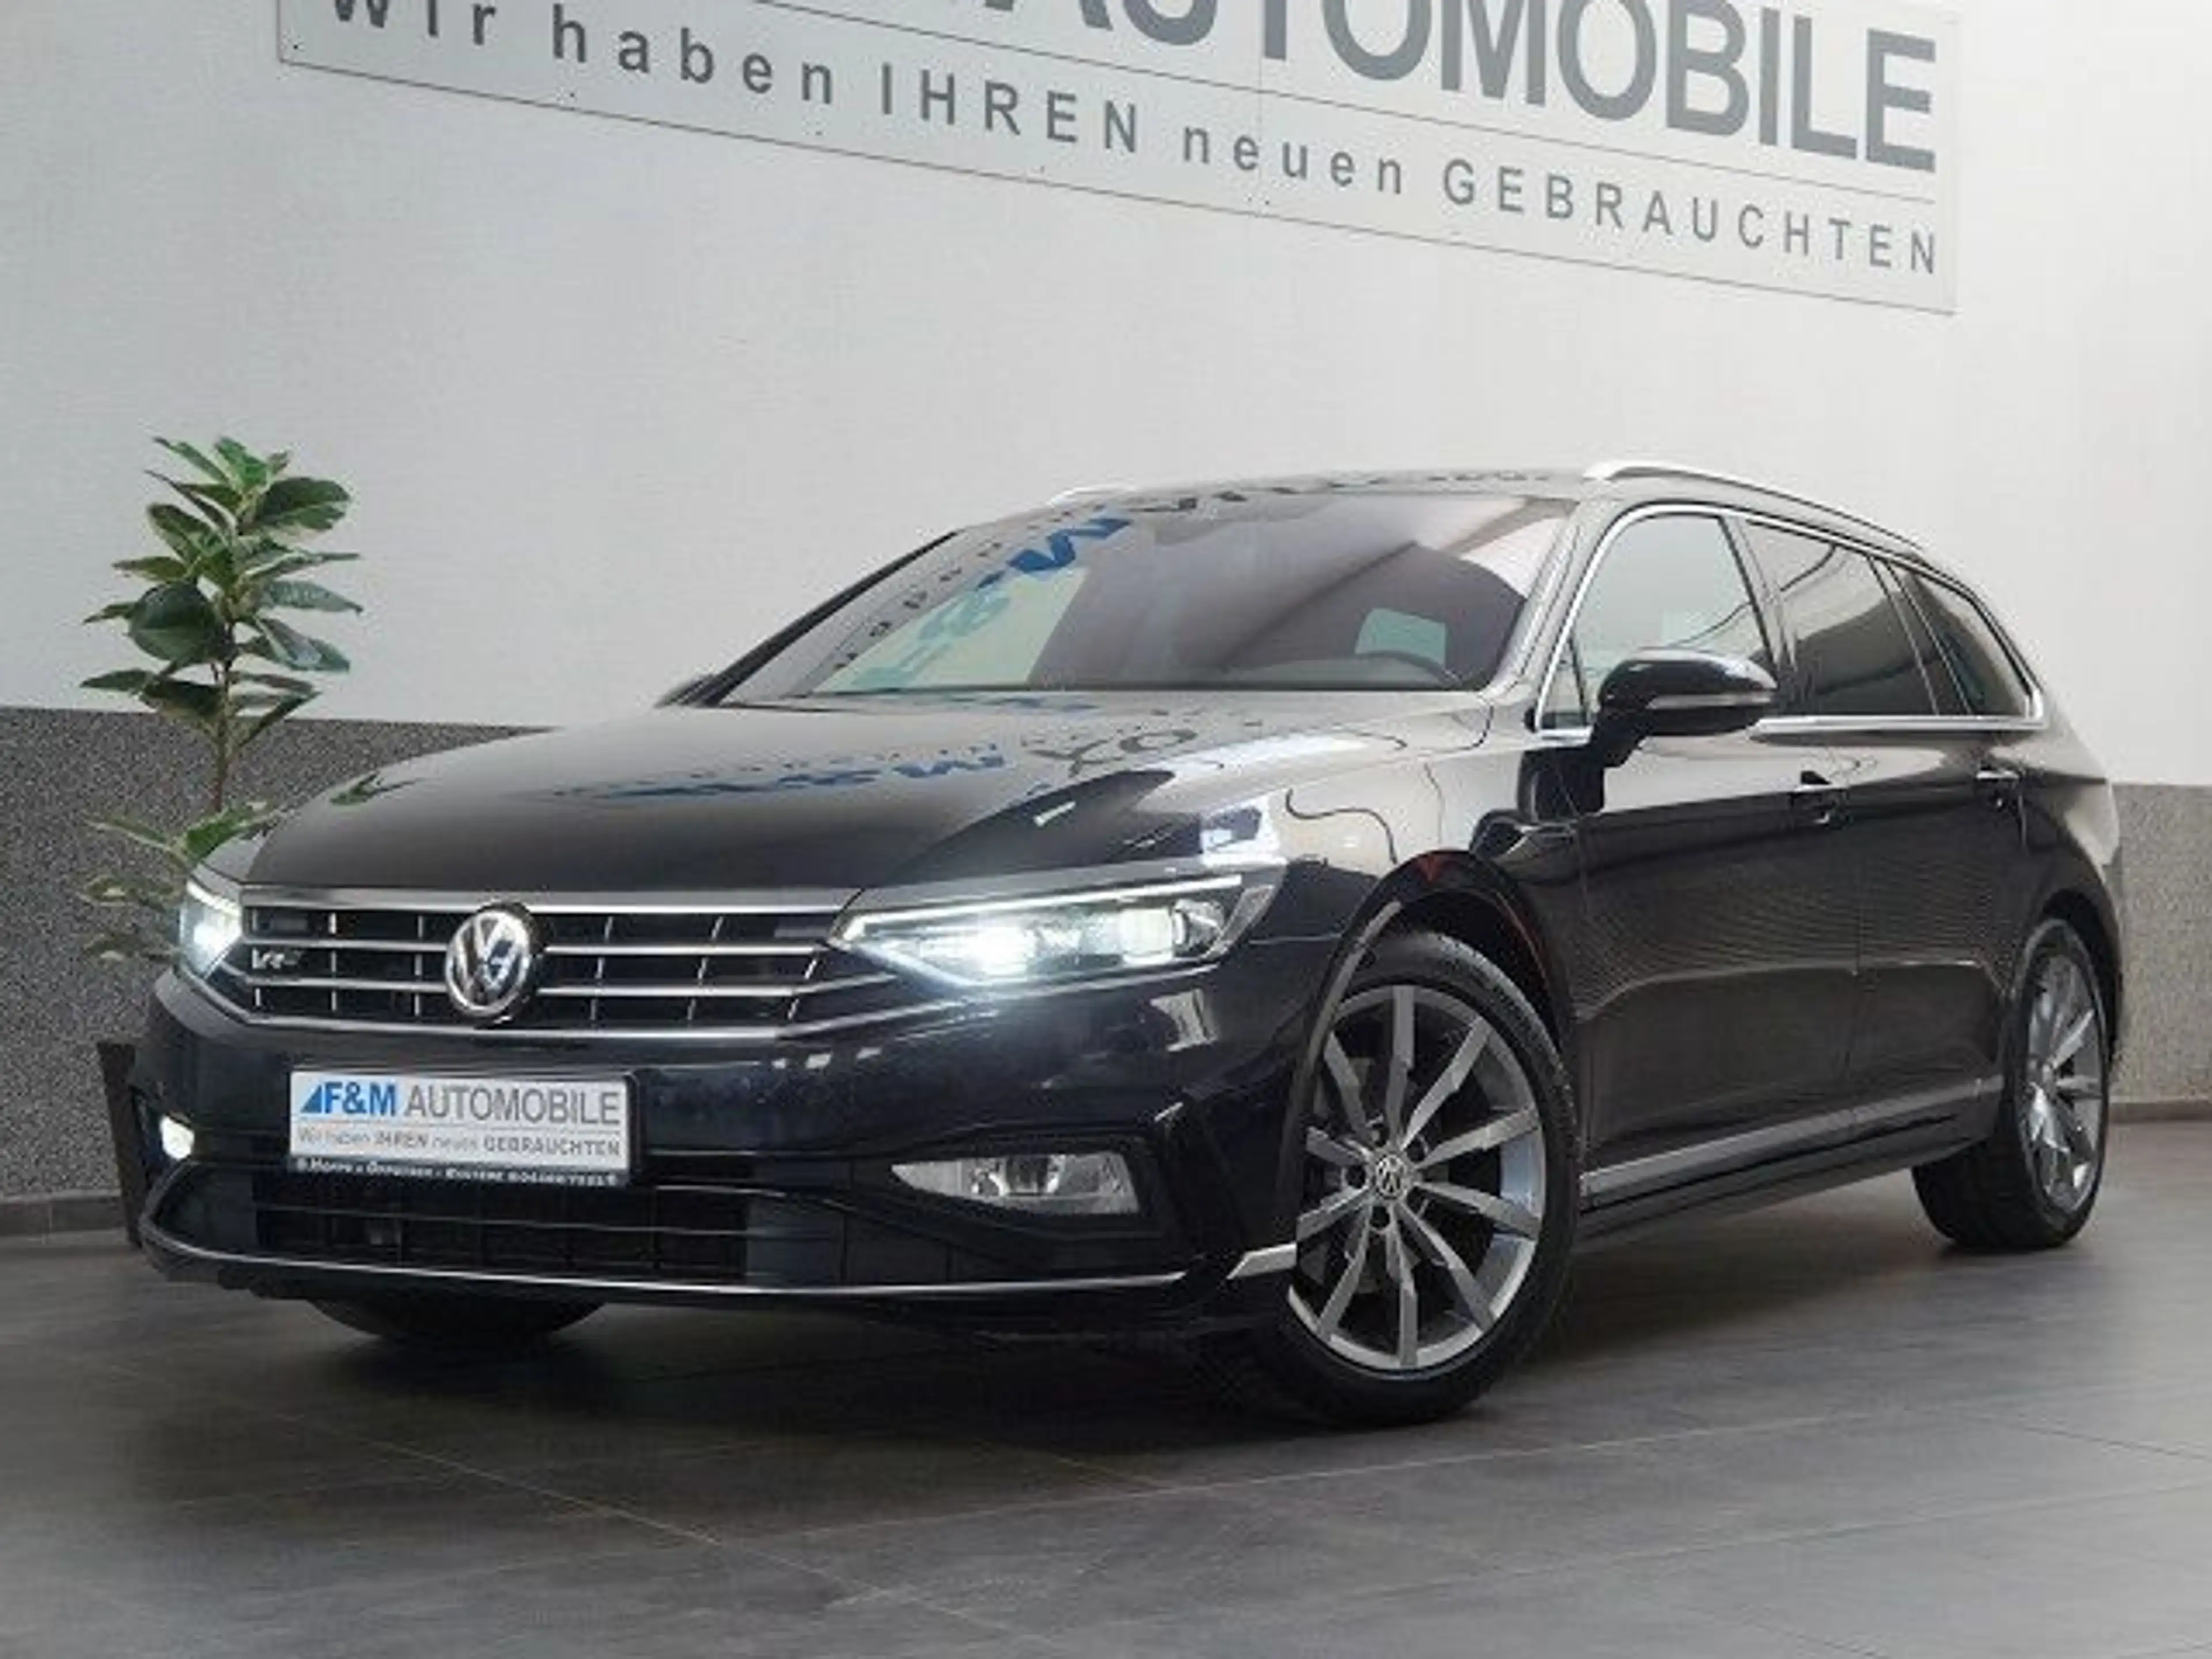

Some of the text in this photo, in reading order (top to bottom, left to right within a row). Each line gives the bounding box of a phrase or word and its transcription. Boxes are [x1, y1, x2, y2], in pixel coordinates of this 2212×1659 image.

[551, 2, 832, 105] haben
[880, 62, 1137, 154] IHREN
[1181, 126, 1402, 196] neuen
[1442, 158, 1936, 275] GEBRAUCHTEN
[982, 0, 1937, 174] OMOBILE
[324, 1081, 620, 1126] F&M AUTOMOBILE
[483, 1133, 620, 1156] GEBRAUCHTEN
